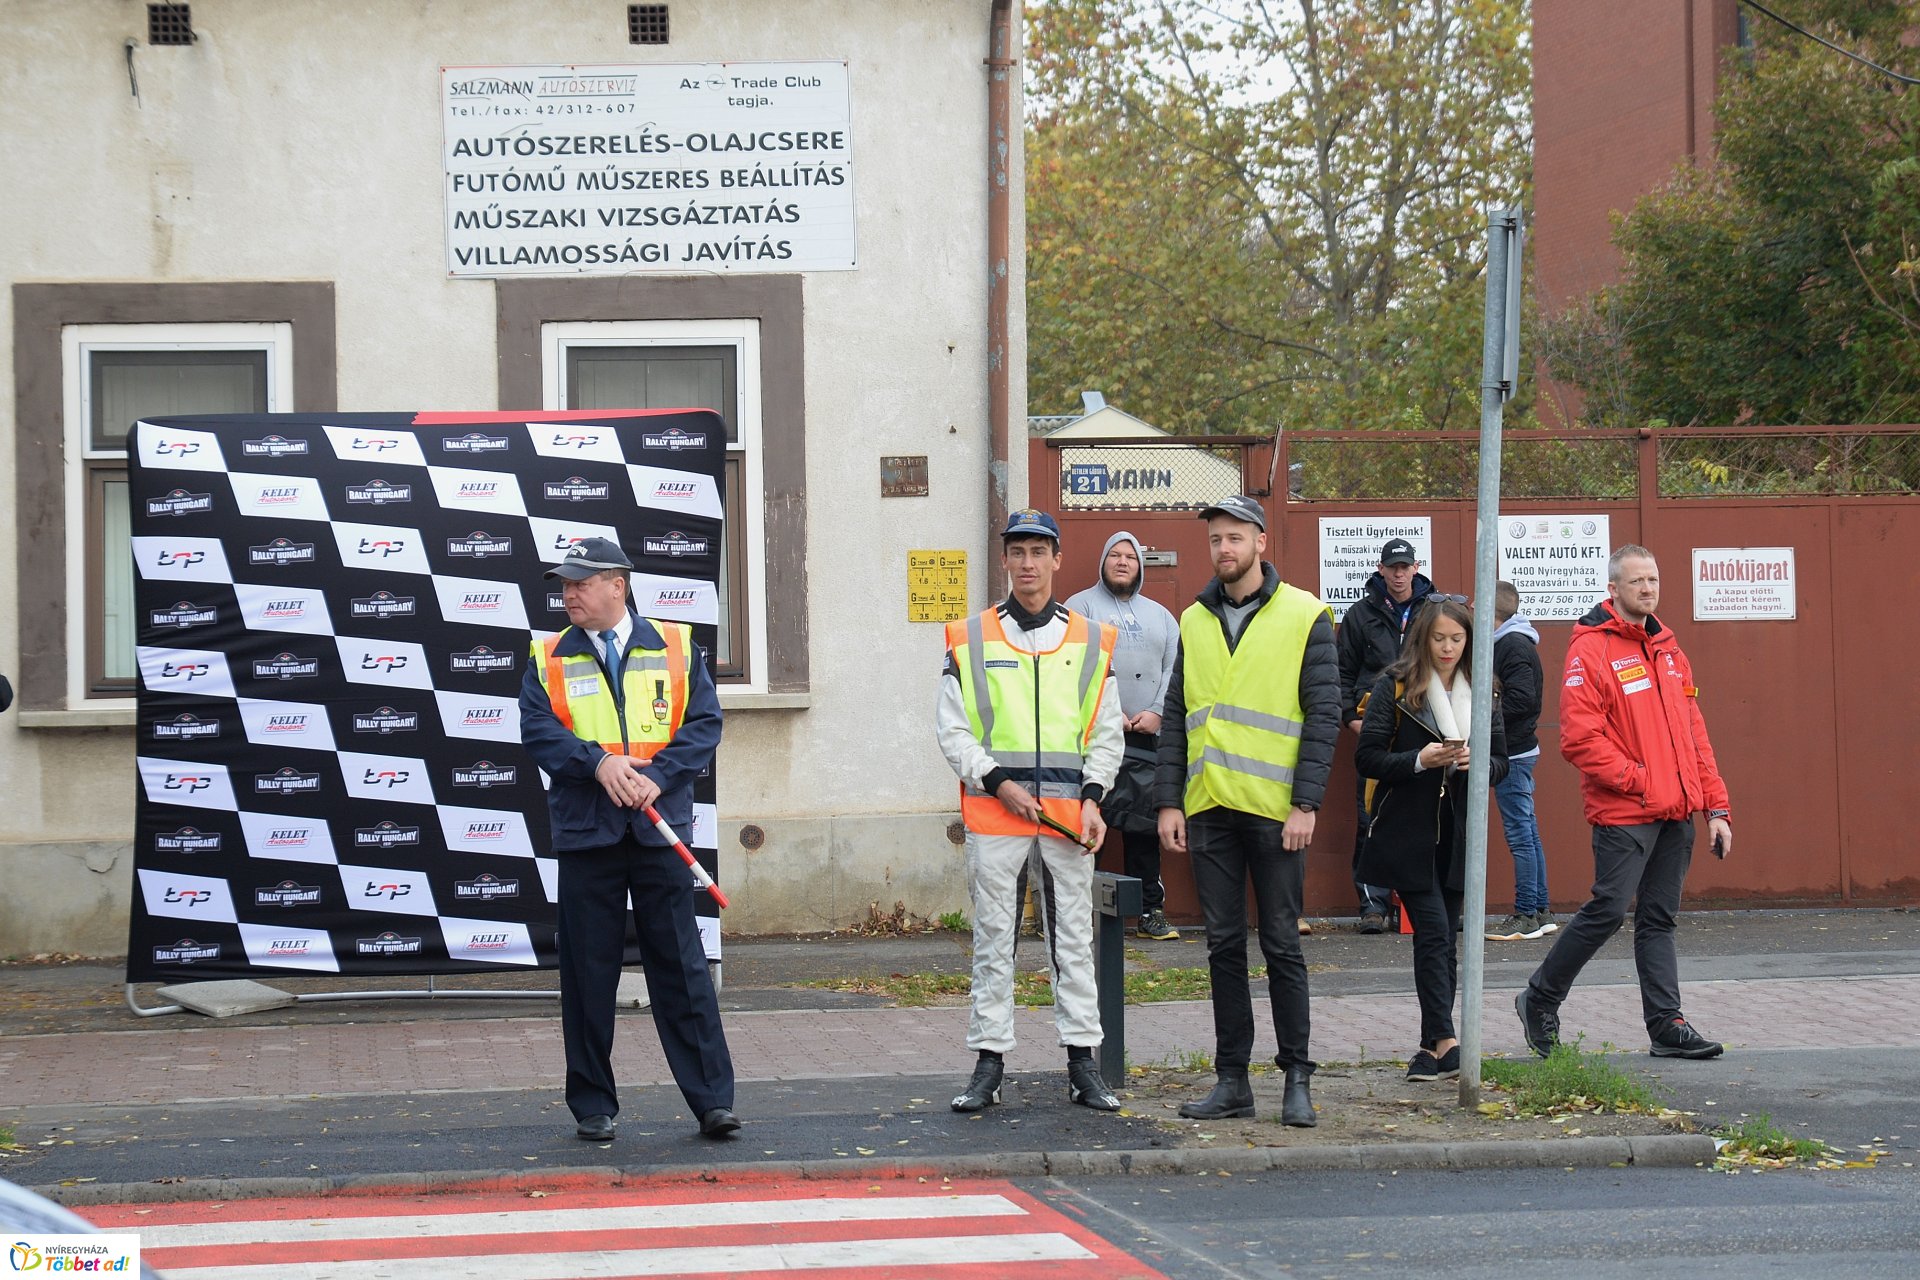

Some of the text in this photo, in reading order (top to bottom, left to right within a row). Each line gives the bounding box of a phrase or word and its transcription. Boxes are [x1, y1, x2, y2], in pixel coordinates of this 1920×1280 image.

[450, 80, 534, 95] SALZMANN
[680, 76, 821, 89] Az Trade Club
[727, 94, 774, 108] tagja.
[451, 104, 635, 116] Tel./fax: 42/312-607
[452, 128, 844, 157] AUTÓSZERELÉS-OLAJCSERE
[452, 160, 845, 193] FUTÓMŰ MŰSZERES BEÁLLÍTÁS
[454, 198, 800, 229] MŰSZAKI VIZSGÁZTATÁS
[455, 234, 793, 266] VILLAMOSSÁGI JAVÍTÁS
[460, 483, 498, 492] KELET
[658, 482, 696, 492] KELET
[1077, 476, 1101, 492] 21
[261, 487, 299, 497] KELET
[349, 491, 372, 499] RALLY
[373, 490, 408, 498] HUNGARY
[571, 487, 606, 495] HUNGARY
[150, 504, 173, 512] RALLY
[174, 499, 208, 510] HUNGARY
[1326, 525, 1423, 538] Tisztelt Ügyfeleink!
[451, 543, 473, 552] RALLY
[475, 543, 508, 551] HUNGARY
[647, 542, 669, 550] RALLY
[671, 543, 704, 551] HUNGARY
[1341, 545, 1370, 553] műszaki
[1505, 543, 1604, 559] VALENT AUTÓ KFT.
[253, 551, 275, 560] RALLY
[277, 549, 311, 558] HUNGARY
[911, 557, 916, 566] G
[940, 557, 946, 566] G
[1324, 559, 1356, 567] továbbra
[1358, 559, 1364, 567] is
[1511, 567, 1534, 575] 4400
[1511, 578, 1569, 587] Tiszavasvári
[1585, 578, 1600, 587] 54.
[463, 594, 501, 603] KELET
[658, 591, 696, 600] KELET
[911, 593, 916, 602] G
[941, 593, 946, 602] G
[1326, 588, 1366, 599] VALENT
[1539, 595, 1555, 603] 42/
[266, 601, 305, 611] KELET
[354, 604, 377, 612] RALLY
[378, 602, 412, 611] HUNGARY
[1751, 603, 1786, 612] hagyni.
[1519, 608, 1531, 616] 36
[1534, 608, 1549, 616] 30/
[1552, 608, 1569, 616] 565
[154, 615, 177, 623] RALLY
[178, 612, 214, 621] HUNGARY
[454, 658, 476, 667] RALLY
[477, 657, 511, 666] HUNGARY
[257, 666, 279, 674] RALLY
[280, 664, 315, 672] HUNGARY
[466, 708, 504, 718] KELET
[269, 715, 308, 725] KELET
[357, 719, 379, 728] RALLY
[380, 718, 414, 726] HUNGARY
[157, 726, 180, 734] RALLY
[181, 724, 216, 733] HUNGARY
[456, 773, 478, 782] RALLY
[479, 772, 513, 780] HUNGARY
[259, 780, 281, 788] RALLY
[282, 779, 317, 787] HUNGARY
[468, 823, 506, 832] KELET
[270, 829, 309, 839] KELET
[358, 834, 381, 842] RALLY
[382, 832, 416, 840] HUNGARY
[159, 838, 181, 847] RALLY
[183, 838, 218, 847] HUNGARY
[458, 886, 481, 894] RALLY
[482, 884, 516, 893] HUNGARY
[259, 893, 281, 901] RALLY
[282, 891, 317, 900] HUNGARY
[470, 934, 509, 944] KELET
[271, 940, 310, 949] KELET
[360, 944, 382, 952] RALLY
[383, 942, 418, 951] HUNGARY
[157, 951, 180, 959] RALLY
[181, 949, 217, 957] HUNGARY
